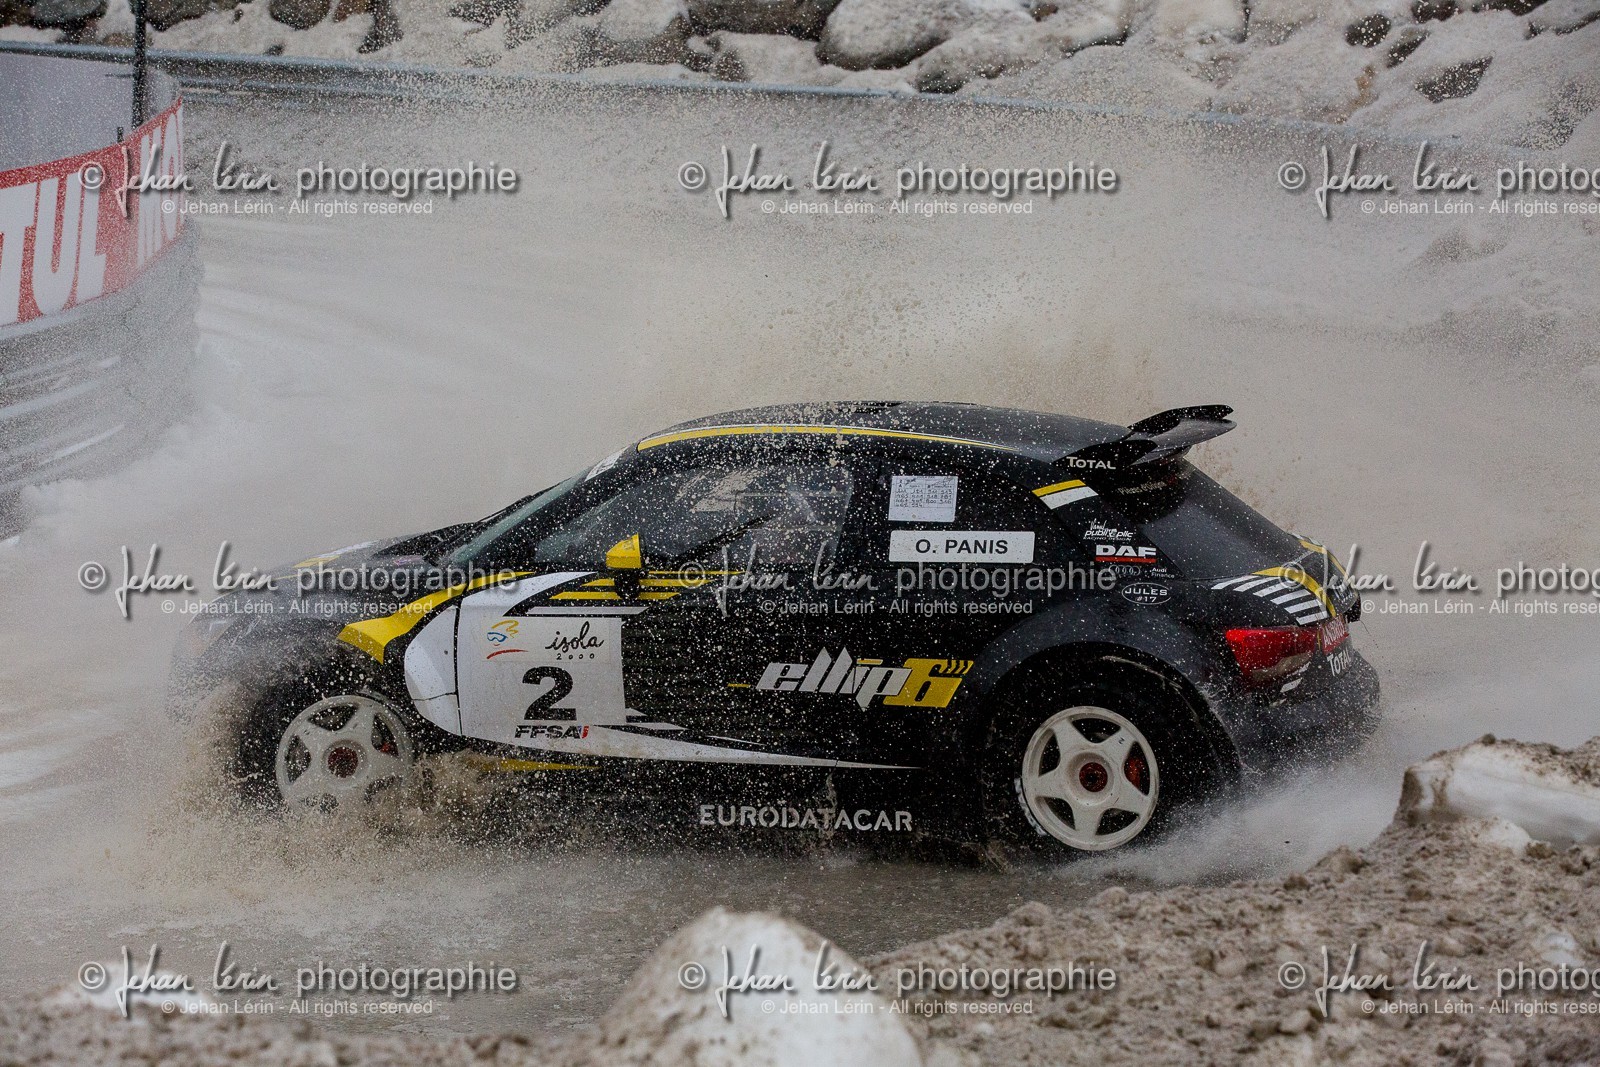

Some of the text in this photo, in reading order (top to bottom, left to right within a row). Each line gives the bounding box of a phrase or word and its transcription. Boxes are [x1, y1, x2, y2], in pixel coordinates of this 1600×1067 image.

[1066, 456, 1117, 470] TOTAL
[915, 538, 1009, 555] O. PANIS
[1095, 544, 1157, 557] DAF
[1124, 587, 1168, 596] JULES
[545, 620, 605, 652] isola
[522, 666, 577, 721] 2
[514, 724, 582, 739] FFSA
[699, 803, 913, 832] EURODATACAR
